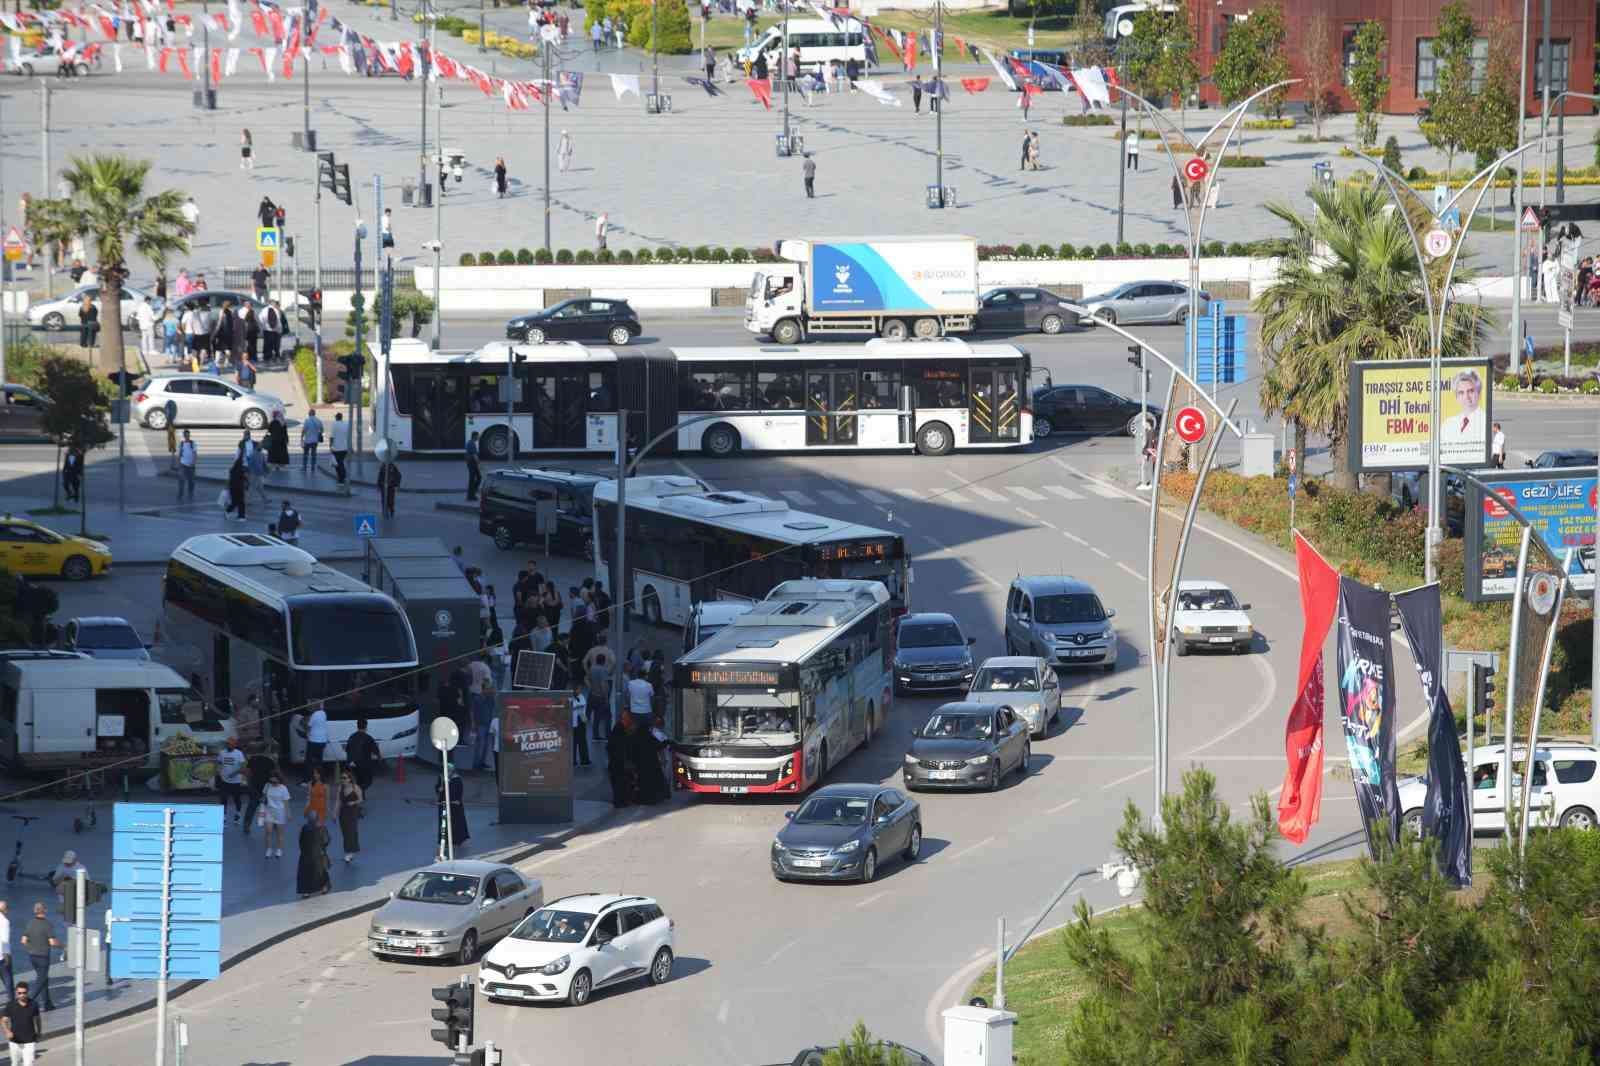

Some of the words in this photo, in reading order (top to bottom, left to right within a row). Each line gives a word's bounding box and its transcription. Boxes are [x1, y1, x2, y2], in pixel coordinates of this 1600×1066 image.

[1406, 381, 1424, 394] SAÇ
[1426, 379, 1452, 392] EMİ
[1557, 484, 1583, 497] LIFE
